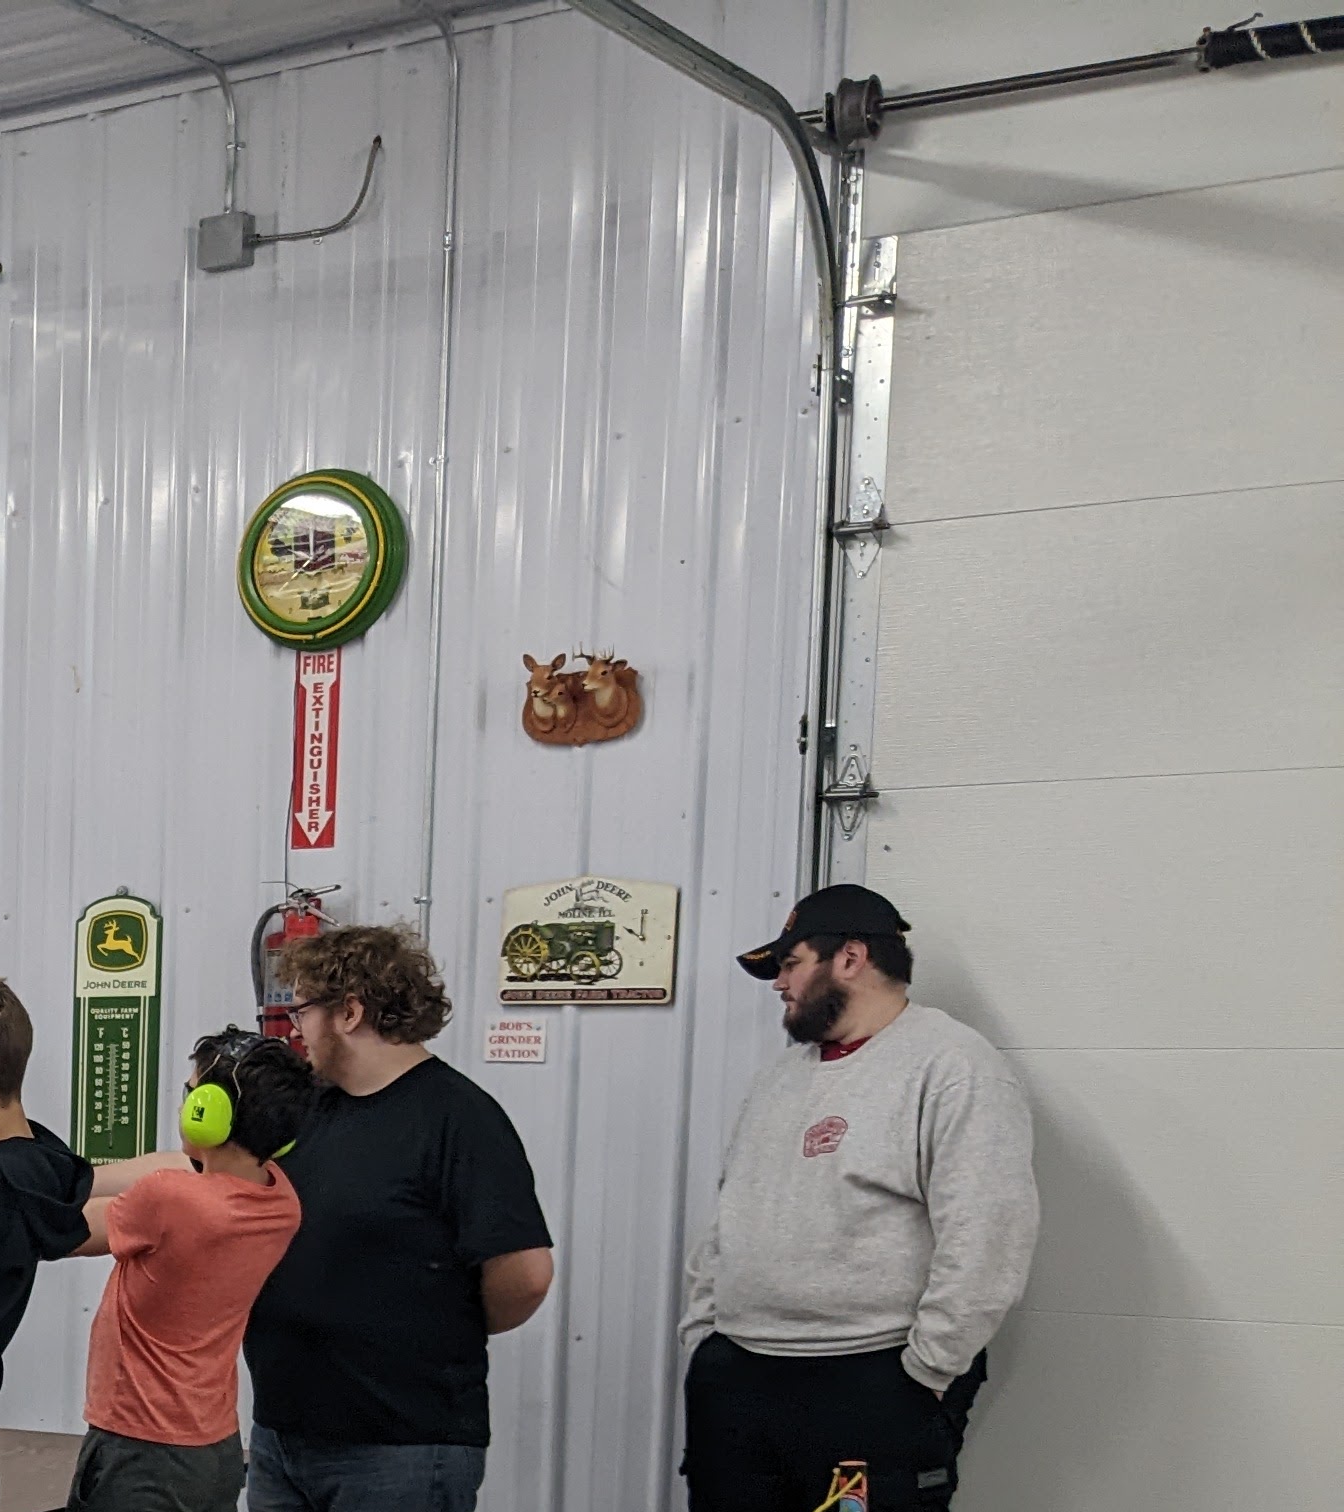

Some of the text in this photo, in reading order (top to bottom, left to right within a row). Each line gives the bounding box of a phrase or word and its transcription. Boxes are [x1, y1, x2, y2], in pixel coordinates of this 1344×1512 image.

[303, 653, 335, 676] FIRE
[307, 682, 324, 833] EXTINGUISHER
[543, 880, 632, 907] JOHN DEERE
[83, 979, 147, 990] JOHN DEERE
[489, 1034, 541, 1045] GRINDER
[489, 1048, 539, 1058] STATION
